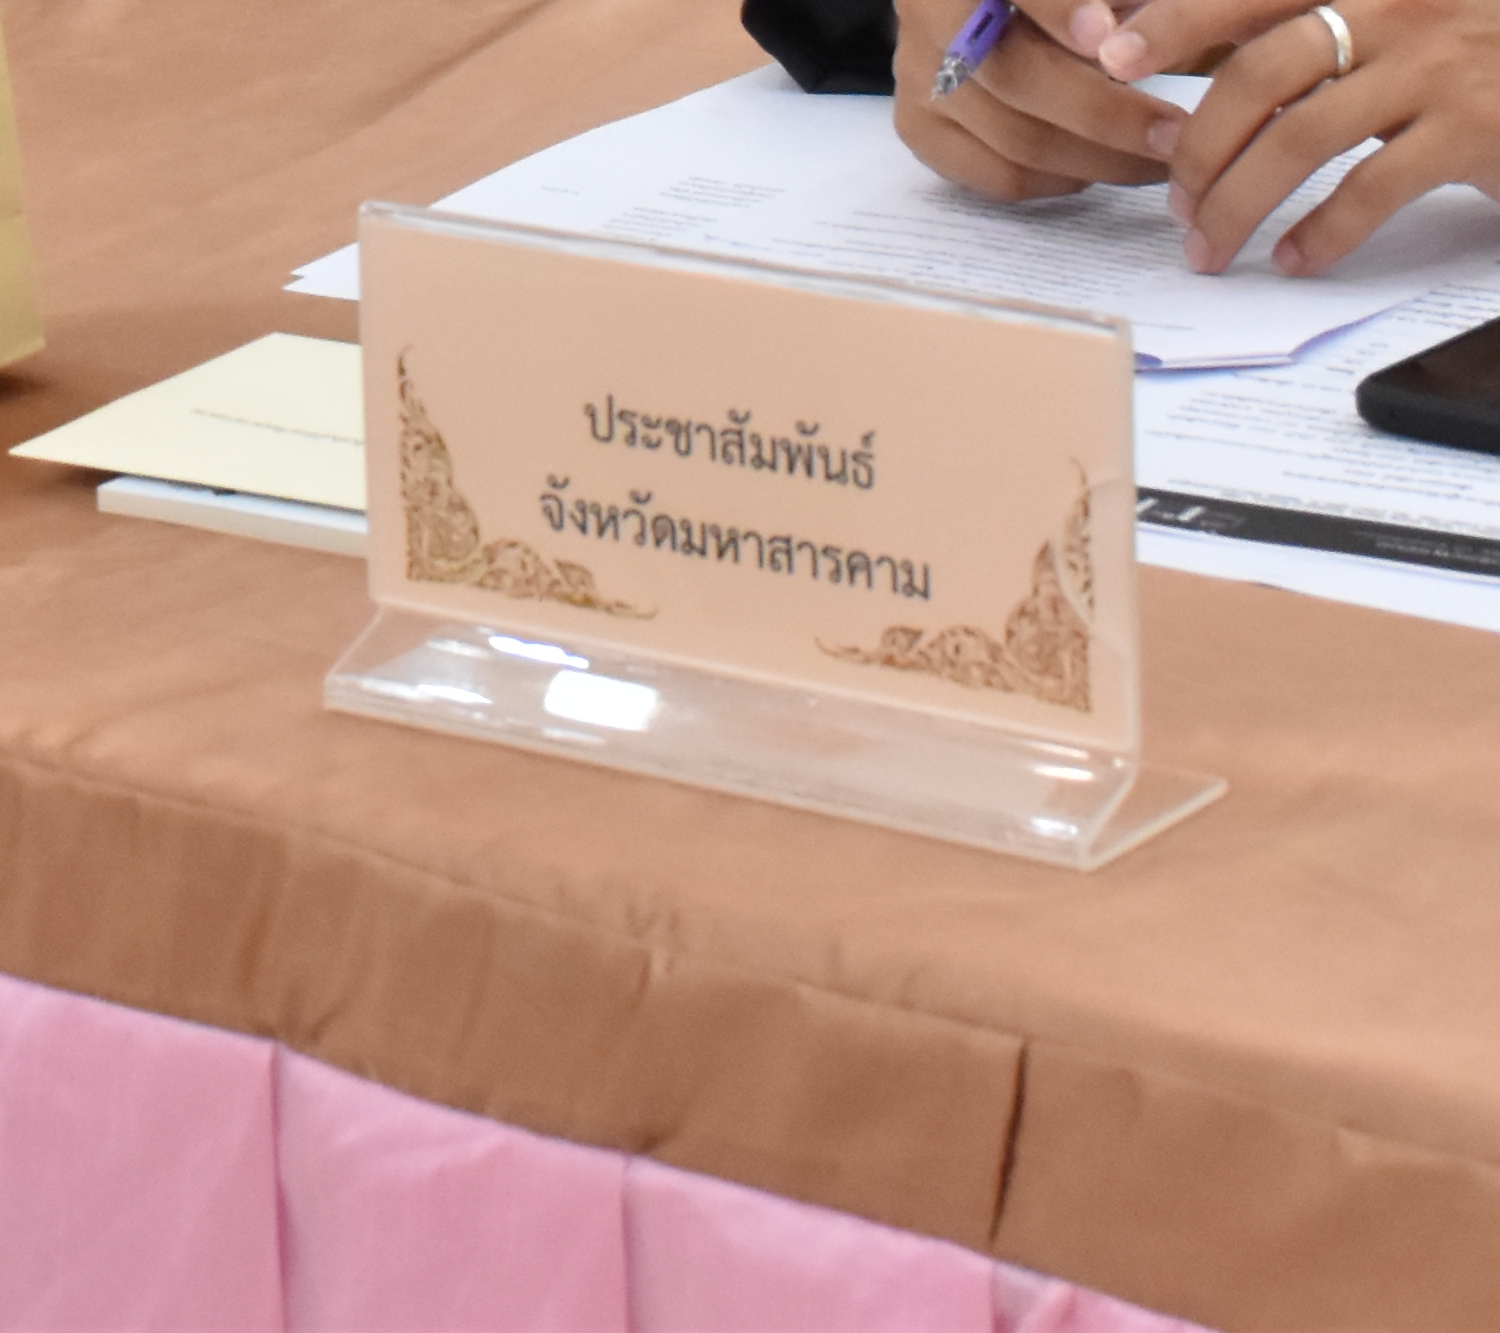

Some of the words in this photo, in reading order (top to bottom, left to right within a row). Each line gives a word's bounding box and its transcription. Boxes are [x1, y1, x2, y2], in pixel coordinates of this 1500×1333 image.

[583, 393, 876, 491] ประชาสัมพันธ์
[537, 476, 932, 603] จังหวัดมหาสารคาม
